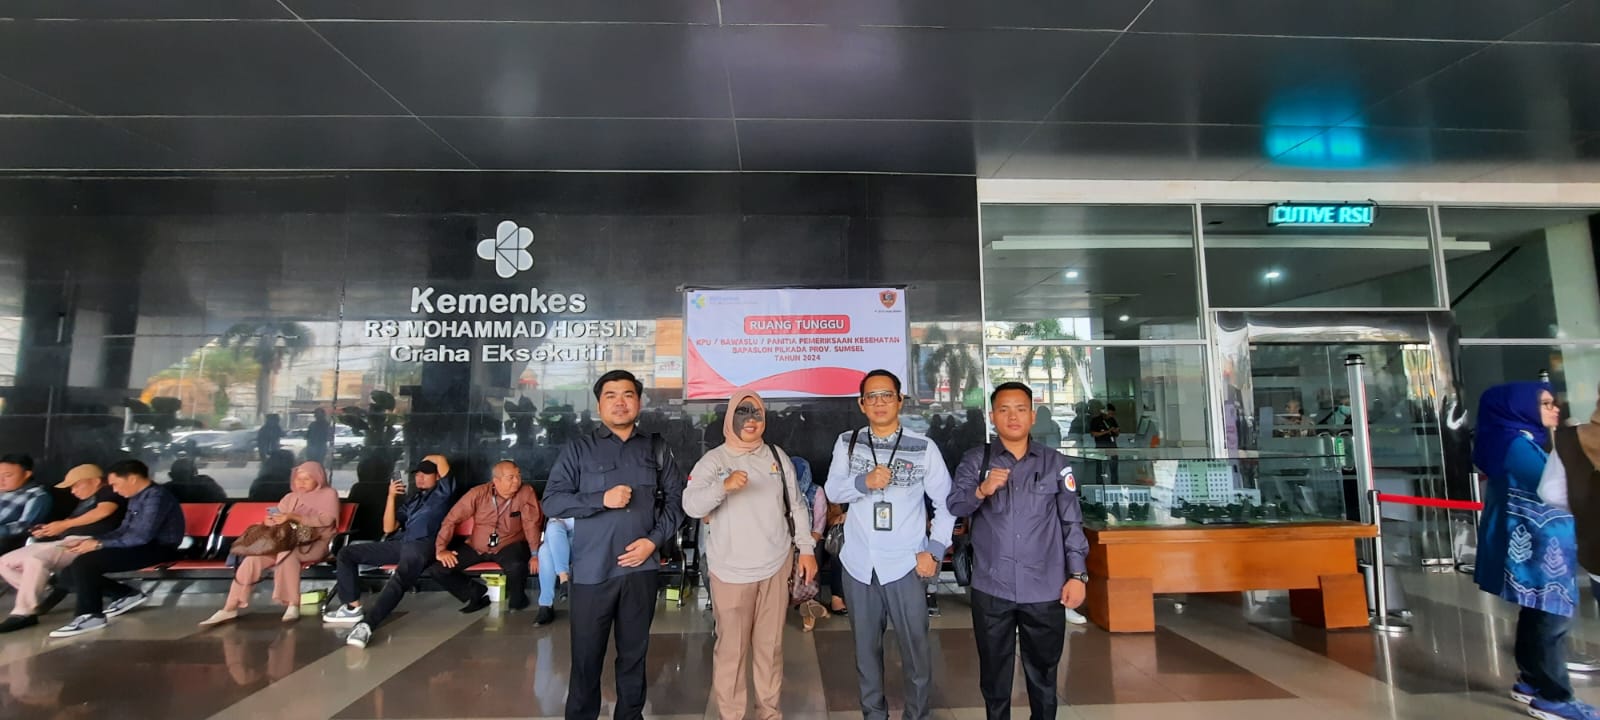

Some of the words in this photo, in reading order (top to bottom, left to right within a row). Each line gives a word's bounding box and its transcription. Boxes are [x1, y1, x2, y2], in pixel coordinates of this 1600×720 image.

[410, 287, 587, 314] Kemenkes
[364, 319, 399, 338] RS
[405, 319, 546, 338] MOHAMMAD
[552, 319, 640, 338] HOESIN
[750, 320, 792, 330] RUANG
[796, 319, 845, 329] TUNGGU
[720, 338, 758, 346] BAWASLU
[799, 337, 853, 345] PEMERIKSAAN
[854, 336, 900, 344] KESEHATAN
[391, 344, 470, 362] Graha
[482, 344, 609, 362] Eksekutif
[809, 345, 832, 353] PROV.
[833, 345, 865, 353] SUMSEL
